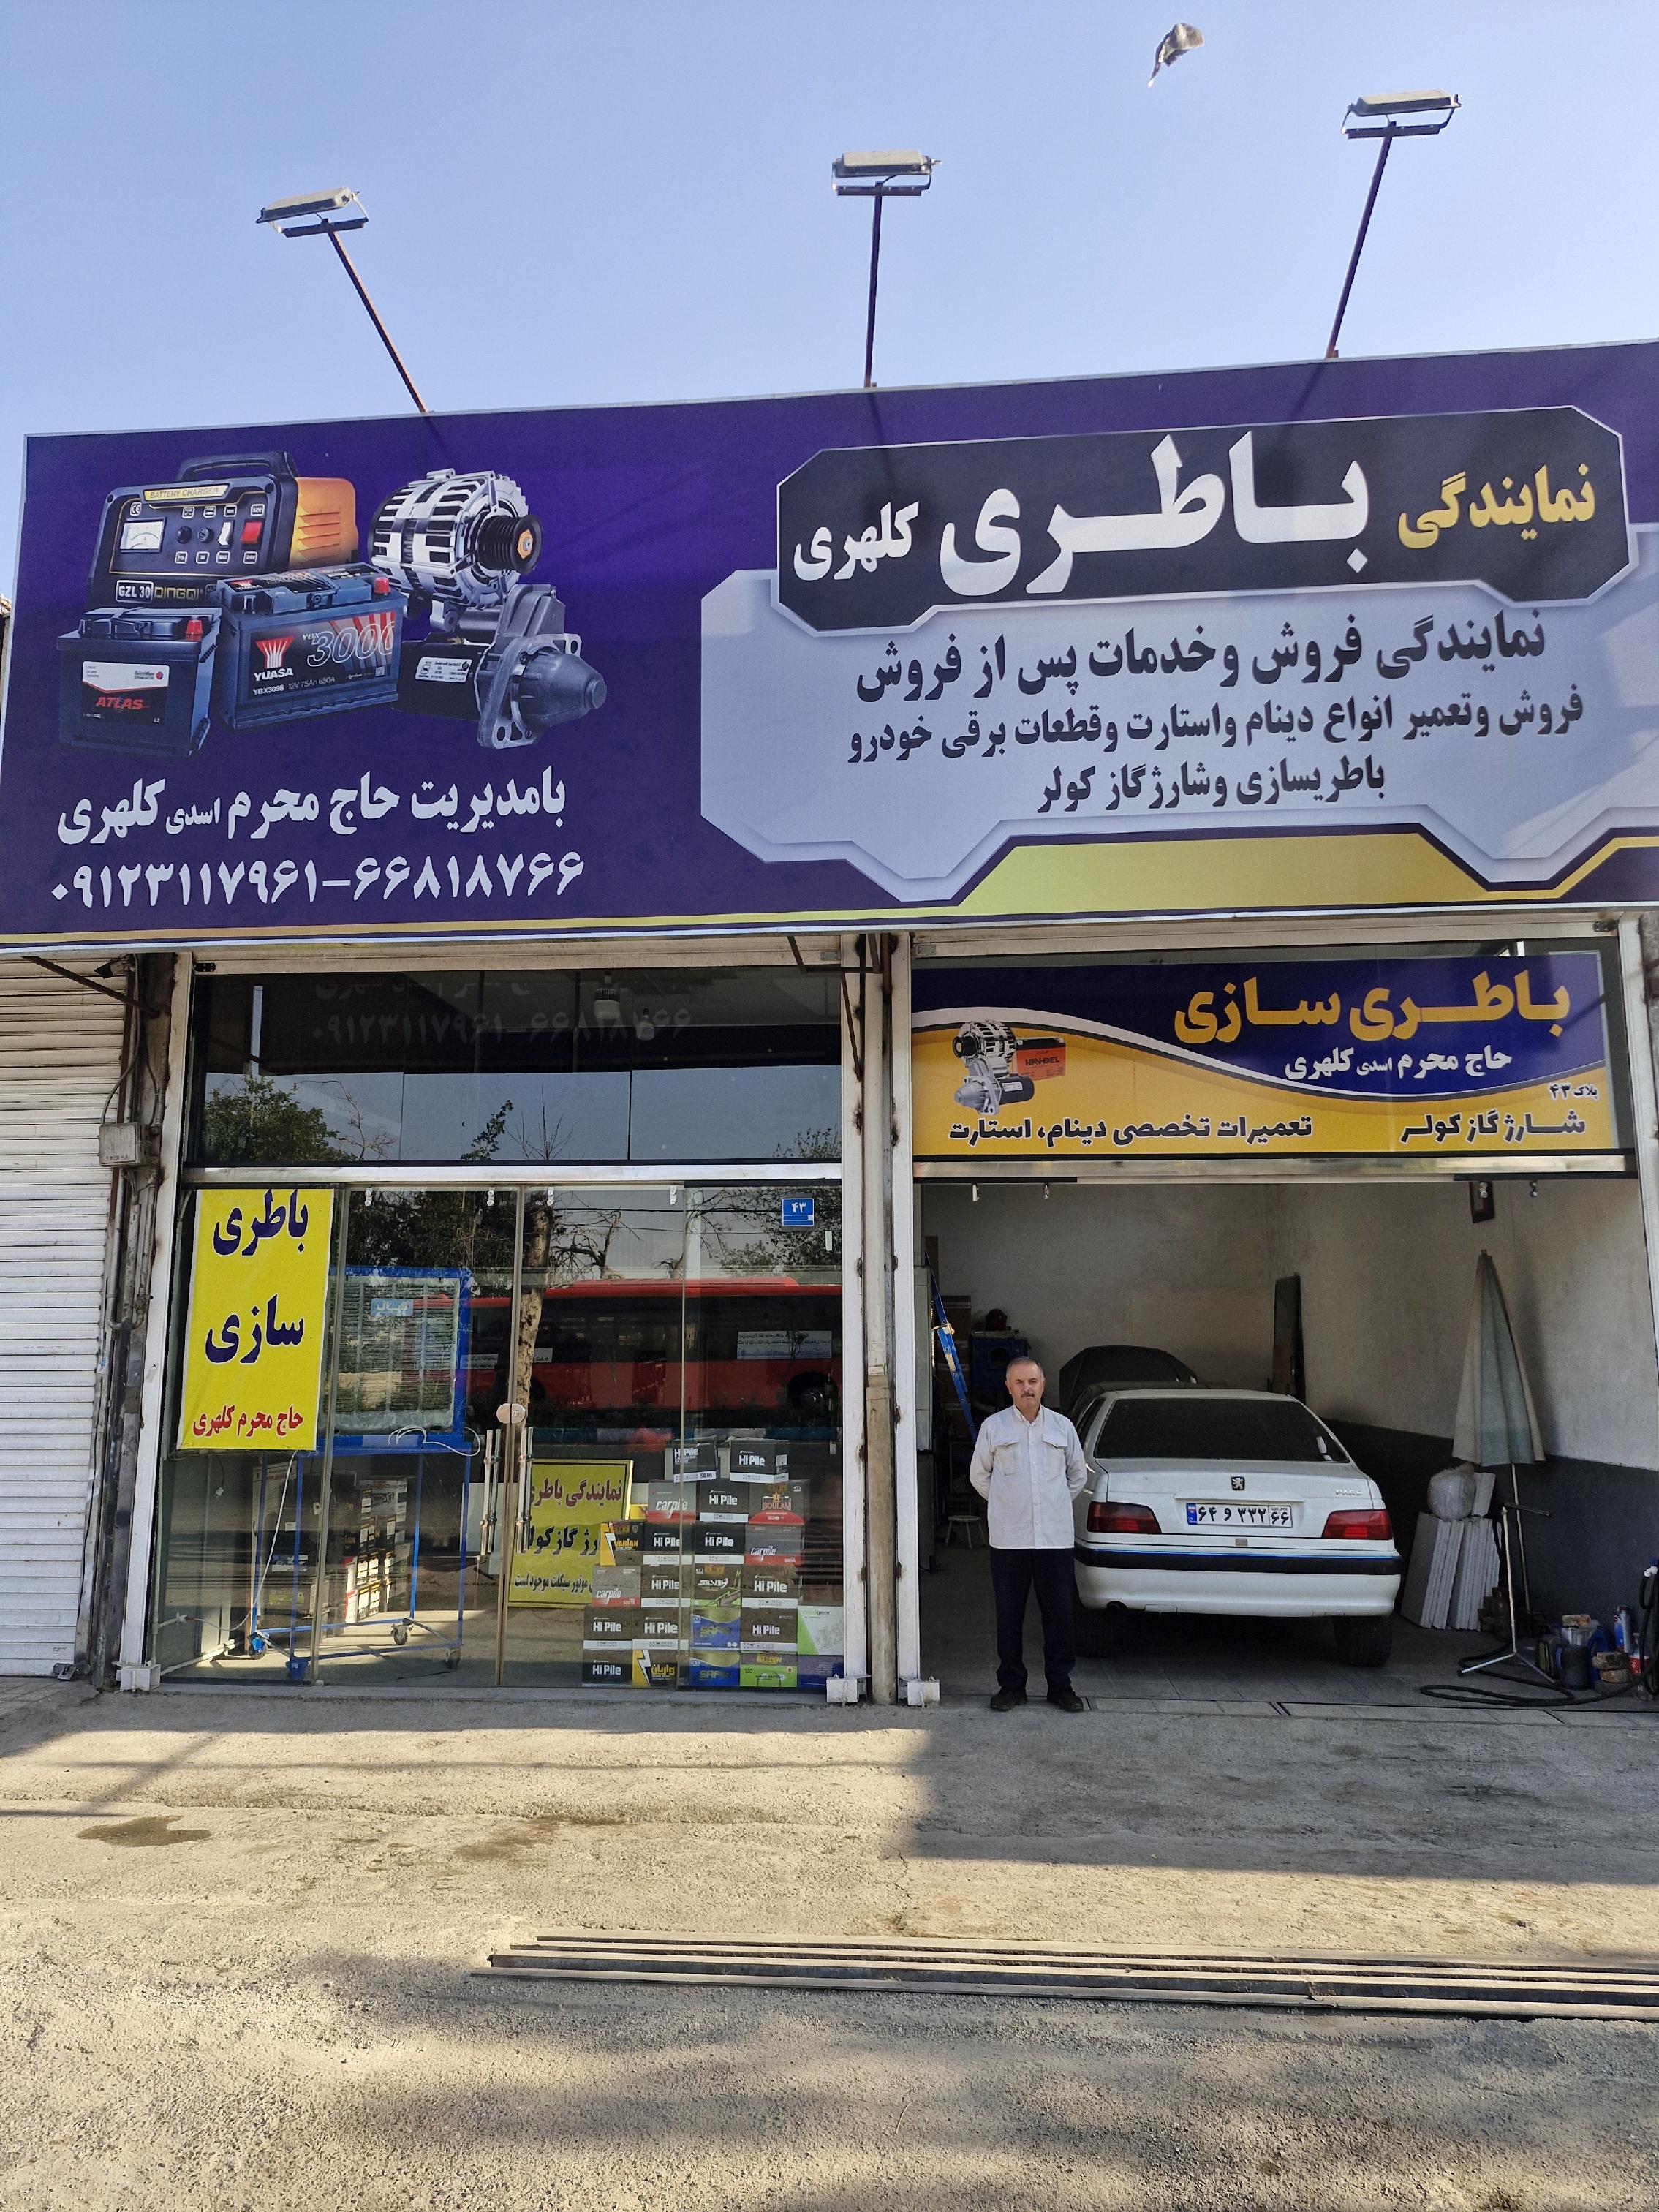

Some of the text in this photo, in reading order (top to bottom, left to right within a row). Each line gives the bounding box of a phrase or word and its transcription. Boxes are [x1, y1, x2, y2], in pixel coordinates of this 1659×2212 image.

[150, 487, 219, 499] BATTERY CHARGER
[793, 430, 1595, 596] نمایندگی باطری کلهری
[118, 585, 151, 598] GZL 30
[1252, 614, 1362, 684] فروش
[1377, 609, 1544, 679] نمایندگی
[254, 668, 293, 682] YUASA
[857, 633, 961, 702] فروش
[973, 633, 1005, 698] از
[1018, 645, 1077, 696] پس
[96, 696, 143, 710] ATLAS
[1324, 694, 1393, 743] انواع
[1499, 684, 1583, 735] فروش
[942, 711, 1006, 759] برقی
[1247, 699, 1313, 746] دینام
[847, 714, 932, 763] خودرو
[330, 770, 401, 835] حاج
[1037, 766, 1096, 813] کولر
[1106, 763, 1146, 811] گاز
[58, 777, 166, 845] کلهری
[165, 796, 221, 834] اسدی
[227, 788, 320, 839] محرم
[1174, 970, 1571, 1043] باطری سازی
[1285, 1045, 1512, 1081] حاج محرم اسدی کلهری
[1550, 1084, 1570, 1098] ۴۳
[950, 1119, 1031, 1146] استارت
[1113, 1114, 1210, 1145] تخصصی
[1217, 1116, 1312, 1144] تعمیرات
[1400, 1109, 1585, 1143] شارژ گاز کولر
[213, 1189, 308, 1256] باطری
[792, 1202, 806, 1212] ۴۳
[205, 1294, 304, 1364] سازی
[193, 1405, 303, 1437] حاج محرم کلهری
[739, 1455, 765, 1466] Hi Pile
[566, 1479, 621, 1506] نمایندگی
[709, 1495, 738, 1505] Hi Pile
[656, 1498, 688, 1519] carpie
[1198, 1506, 1217, 1522] ۶۴
[1271, 1511, 1289, 1525] ۶۶
[528, 1525, 554, 1554] کول
[553, 1526, 578, 1555] گاز
[654, 1537, 680, 1547] Hi Pile
[705, 1537, 734, 1547] Hi Pile
[651, 1580, 679, 1590] Hi Pile
[754, 1581, 787, 1593] Hi Pile
[593, 1622, 621, 1632] Hi Pile
[644, 1623, 678, 1634] Hi Pile
[752, 1625, 780, 1635] Hi Pile
[592, 1665, 621, 1675] Hi Pile
